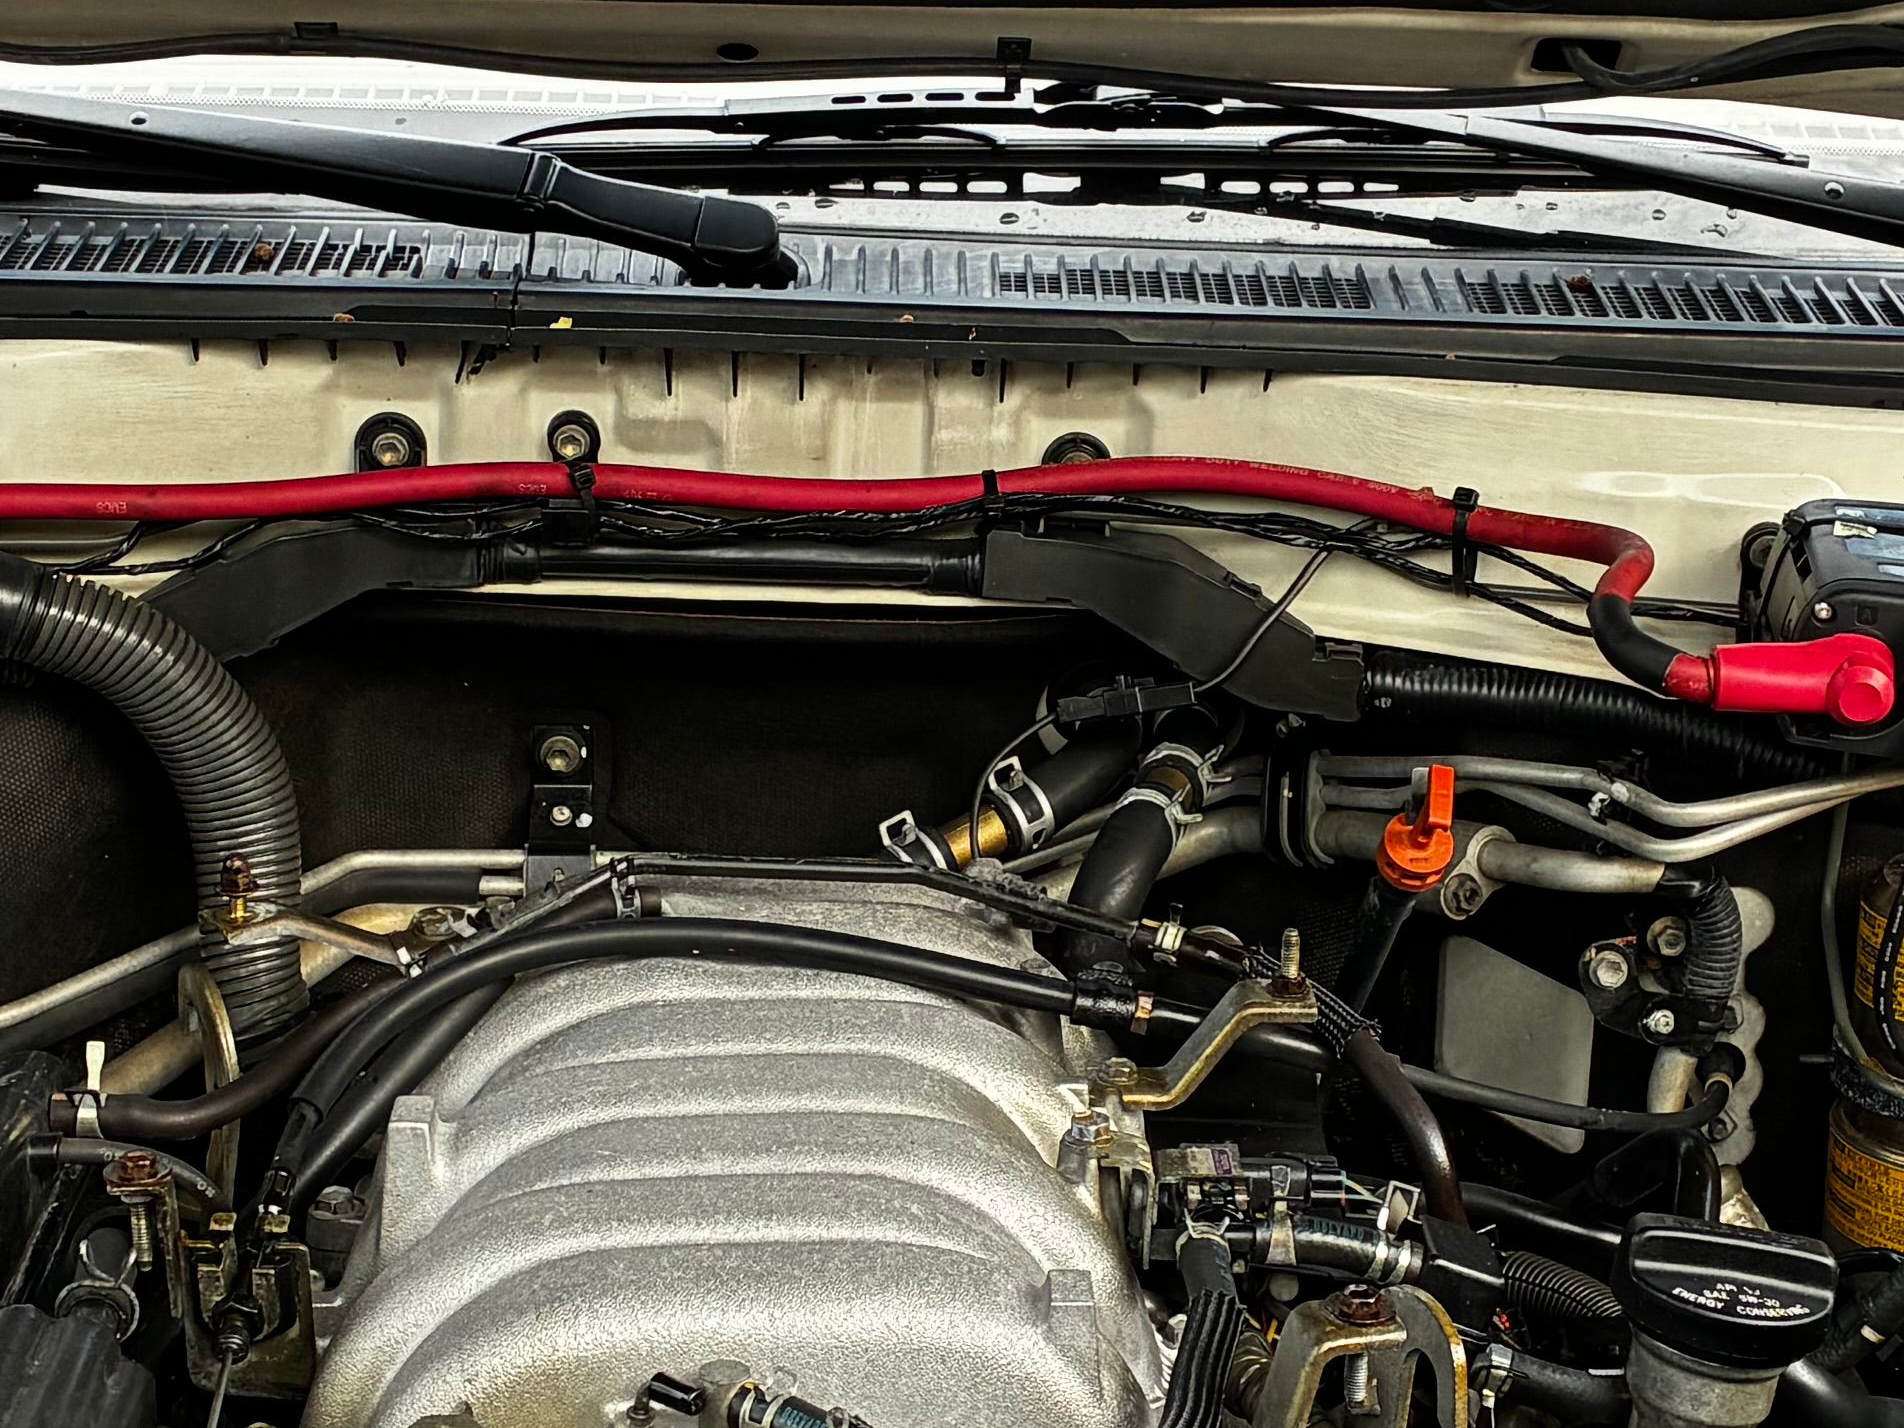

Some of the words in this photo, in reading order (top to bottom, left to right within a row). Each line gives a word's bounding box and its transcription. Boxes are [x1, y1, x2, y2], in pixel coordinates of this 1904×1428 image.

[1250, 461, 1309, 477] WELDING
[96, 501, 127, 514] EUCS
[1672, 1286, 1725, 1310] ENERGY
[1703, 1289, 1730, 1301] SAE
[1738, 1293, 1780, 1308] 5W-30
